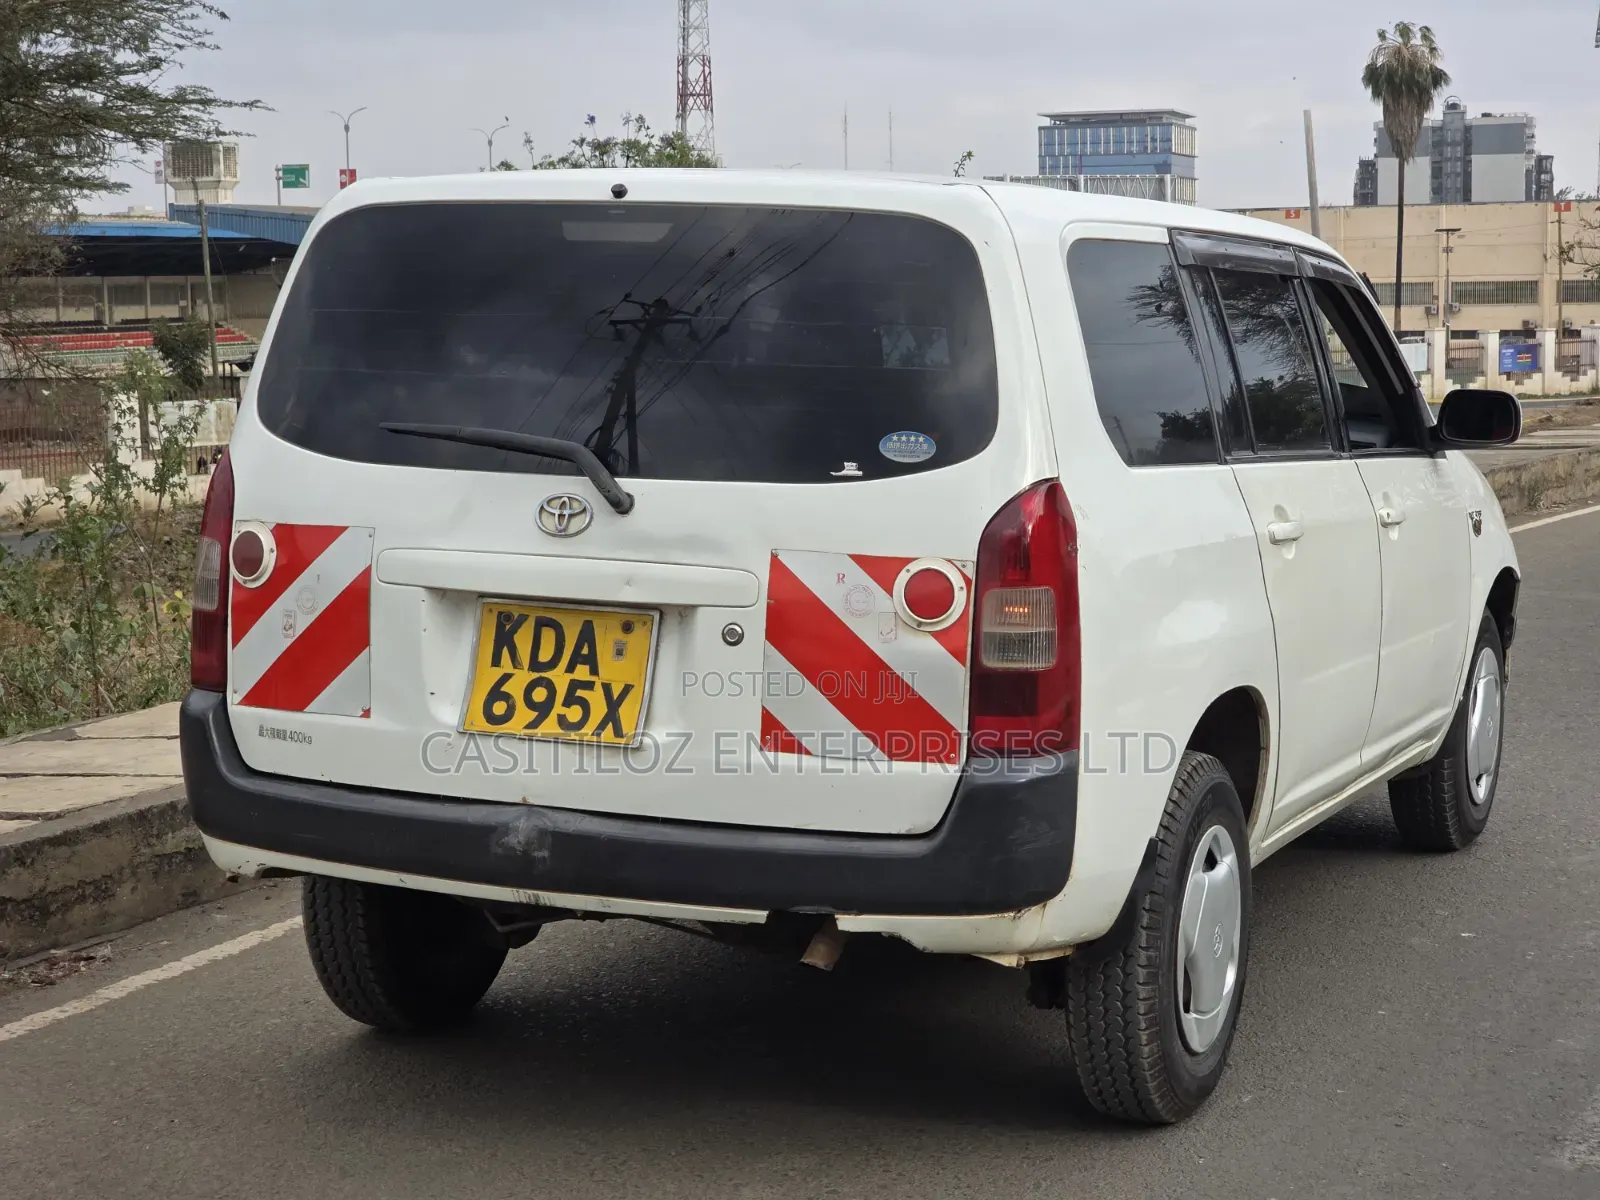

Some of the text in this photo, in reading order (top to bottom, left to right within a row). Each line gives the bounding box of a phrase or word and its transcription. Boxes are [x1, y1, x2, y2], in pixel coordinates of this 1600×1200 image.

[1289, 209, 1296, 218] S
[836, 572, 846, 585] R
[490, 611, 600, 678] KDA
[482, 672, 635, 739] 695X
